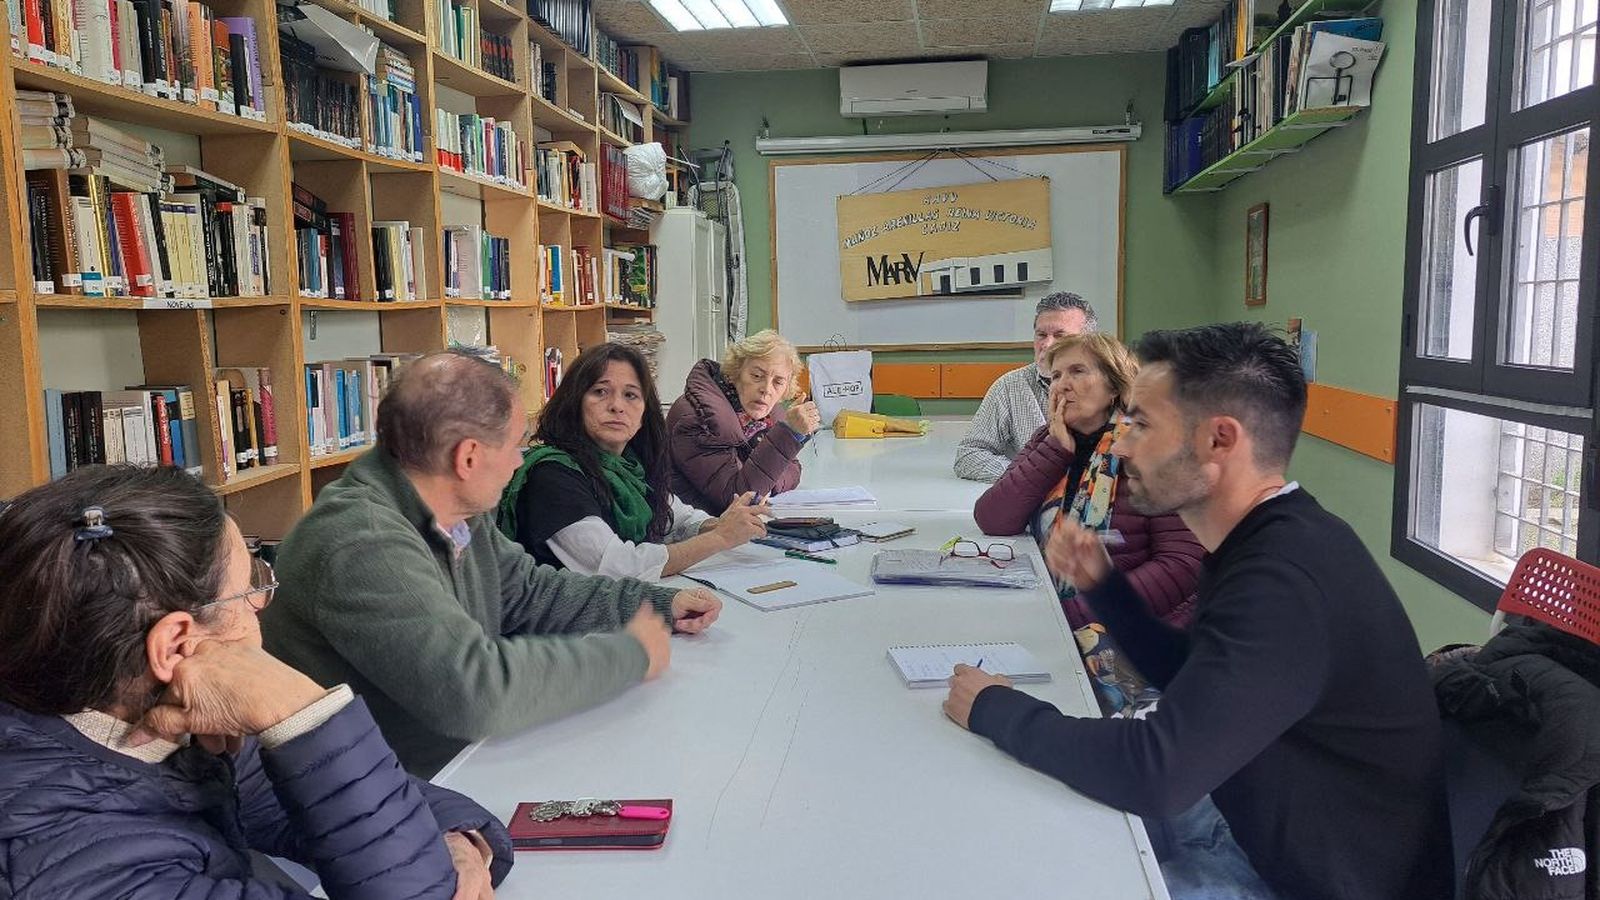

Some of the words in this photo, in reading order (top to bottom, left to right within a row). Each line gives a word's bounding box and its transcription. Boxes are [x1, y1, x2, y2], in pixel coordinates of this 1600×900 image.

[947, 207, 981, 220] REINA
[984, 210, 1037, 230] VICTORIA
[1548, 848, 1573, 859] THE
[1534, 855, 1574, 869] NORTH
[1547, 866, 1576, 876] FACE
